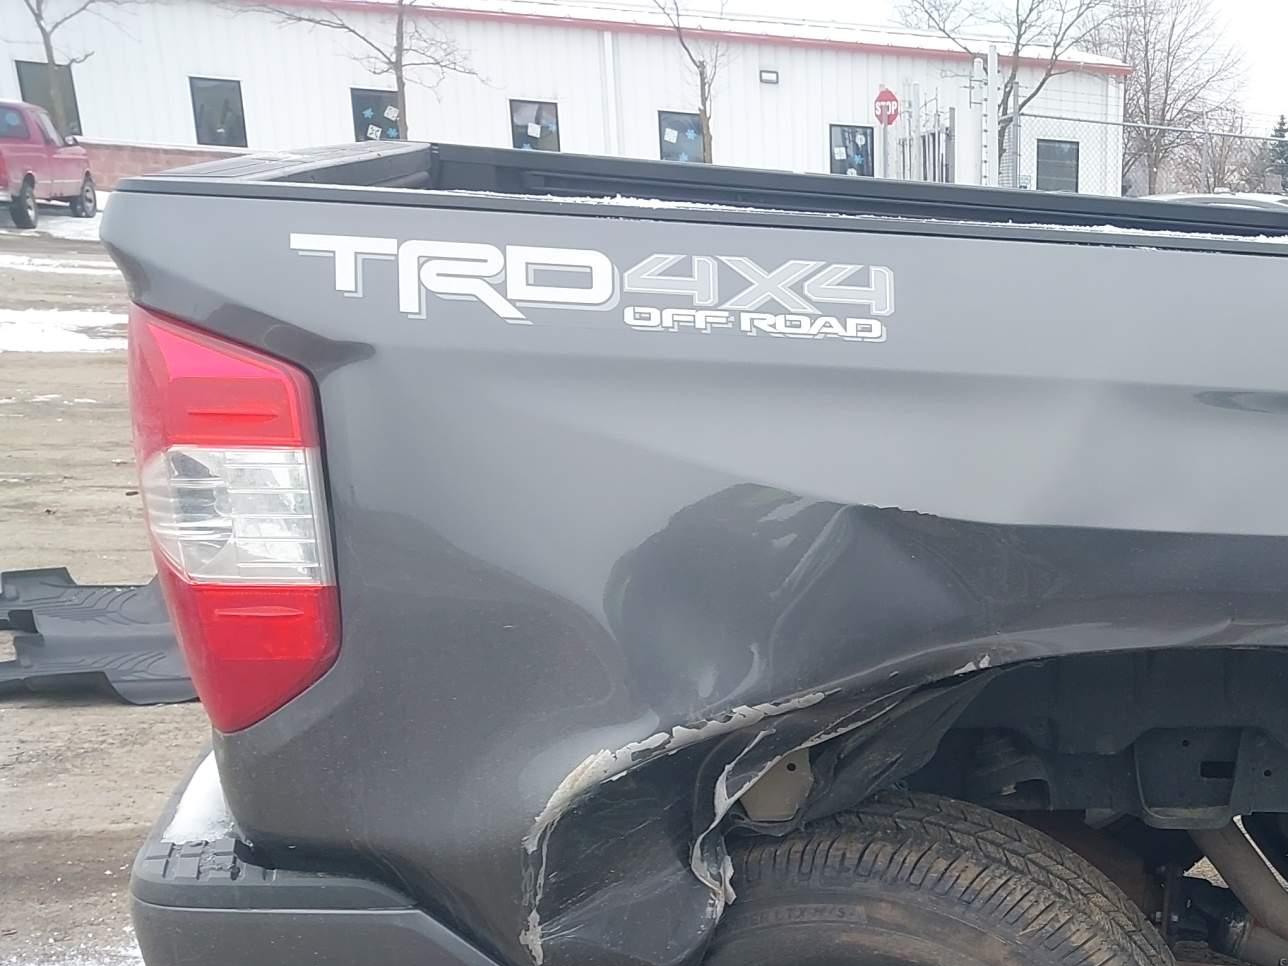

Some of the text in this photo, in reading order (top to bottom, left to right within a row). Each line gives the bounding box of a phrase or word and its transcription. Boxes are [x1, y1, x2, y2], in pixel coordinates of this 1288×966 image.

[290, 233, 622, 324] TRD
[624, 305, 888, 344] OFF ROAD
